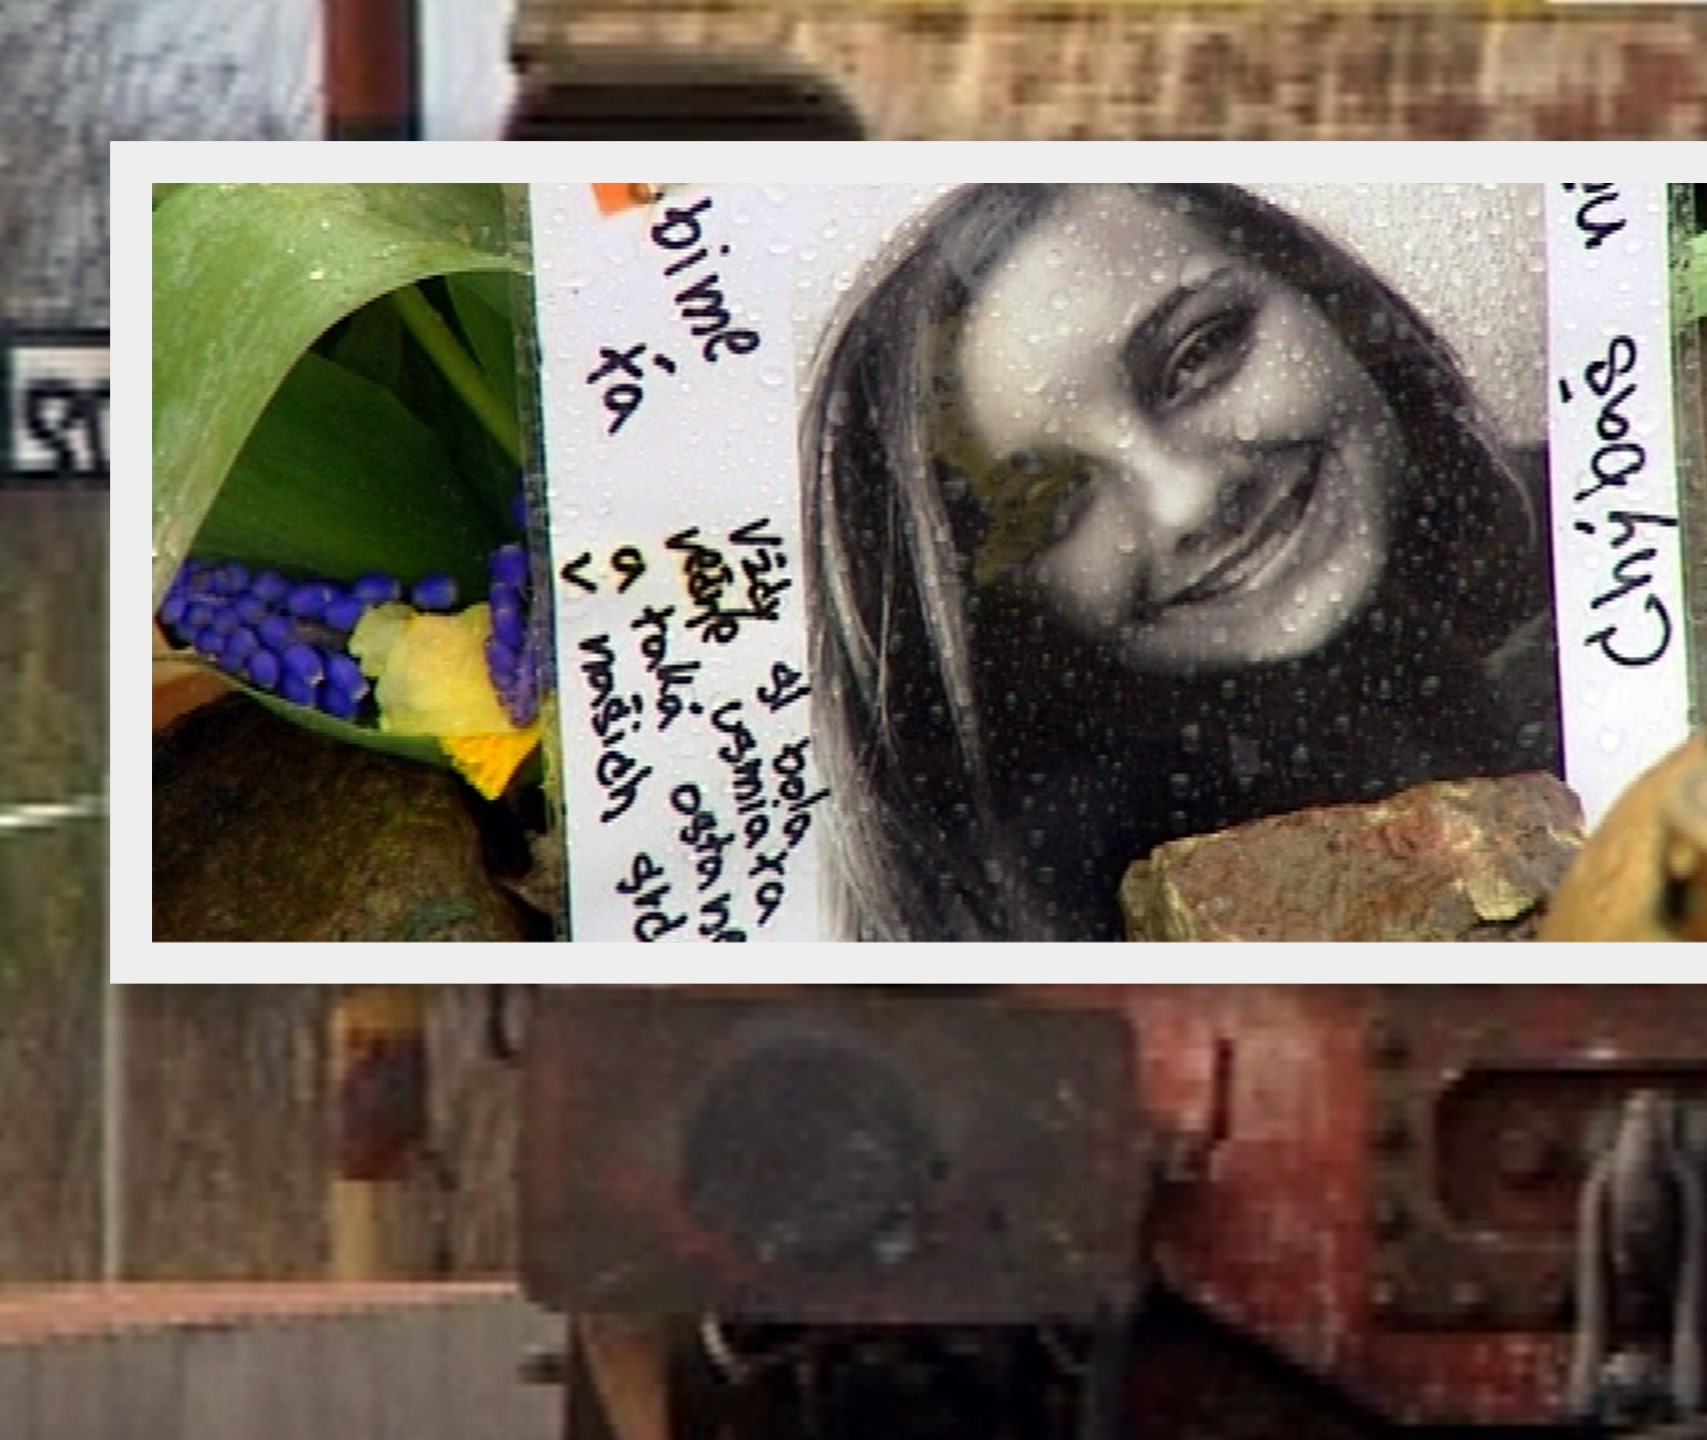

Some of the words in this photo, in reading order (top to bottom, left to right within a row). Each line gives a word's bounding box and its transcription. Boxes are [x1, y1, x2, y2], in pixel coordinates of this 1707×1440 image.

[609, 545, 648, 594] a
[710, 701, 789, 928] usmiata
[772, 736, 832, 849] bola
